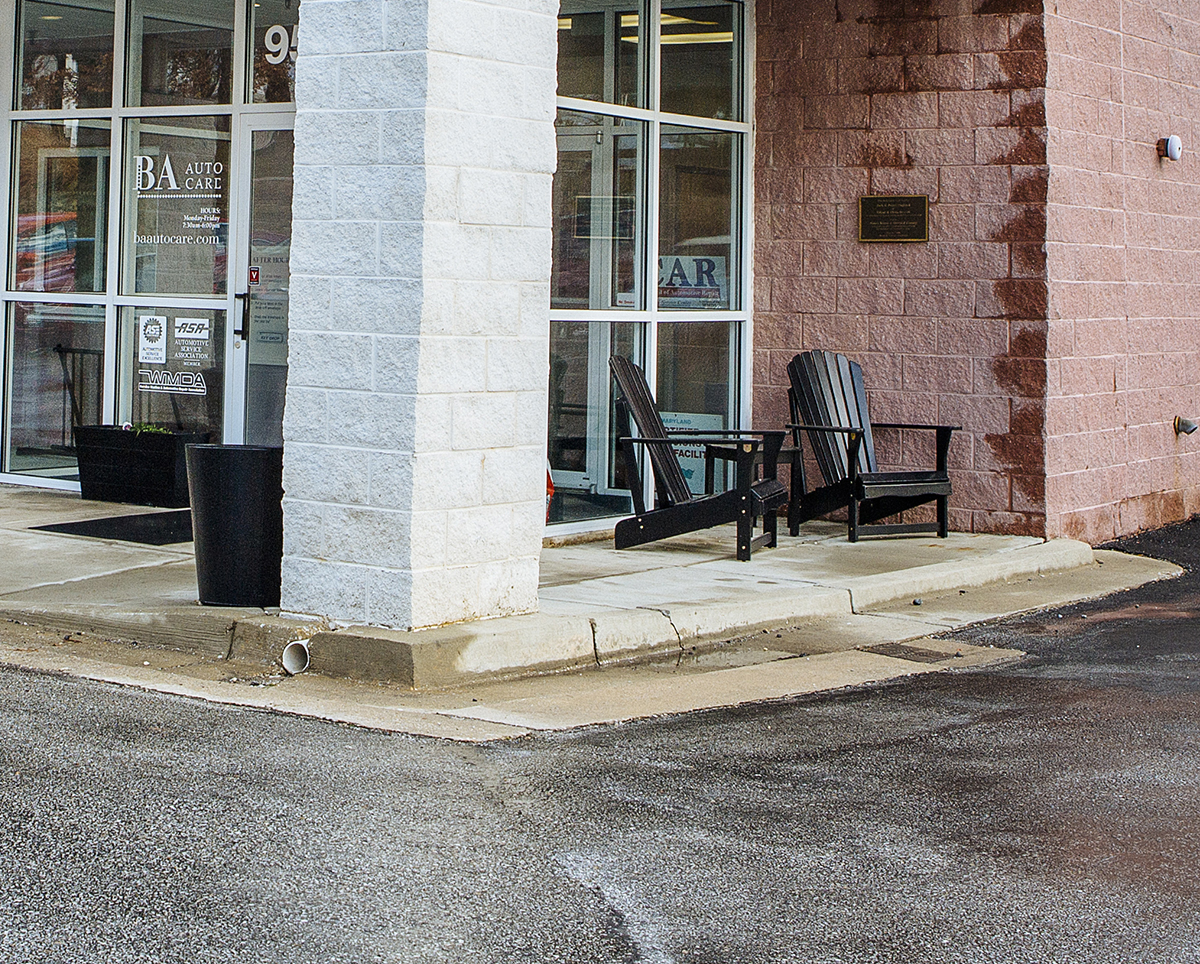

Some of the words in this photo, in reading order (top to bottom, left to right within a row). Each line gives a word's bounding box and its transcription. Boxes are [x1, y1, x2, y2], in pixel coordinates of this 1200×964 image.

[132, 154, 181, 191] BA
[185, 162, 224, 175] AUTO
[185, 177, 222, 190] CARE
[133, 231, 220, 244] baautocare.com
[178, 322, 206, 334] ASA
[175, 339, 209, 347] AUTOMOTIVE
[175, 352, 209, 360] ASSOCIATION
[139, 369, 206, 387] WMDA
